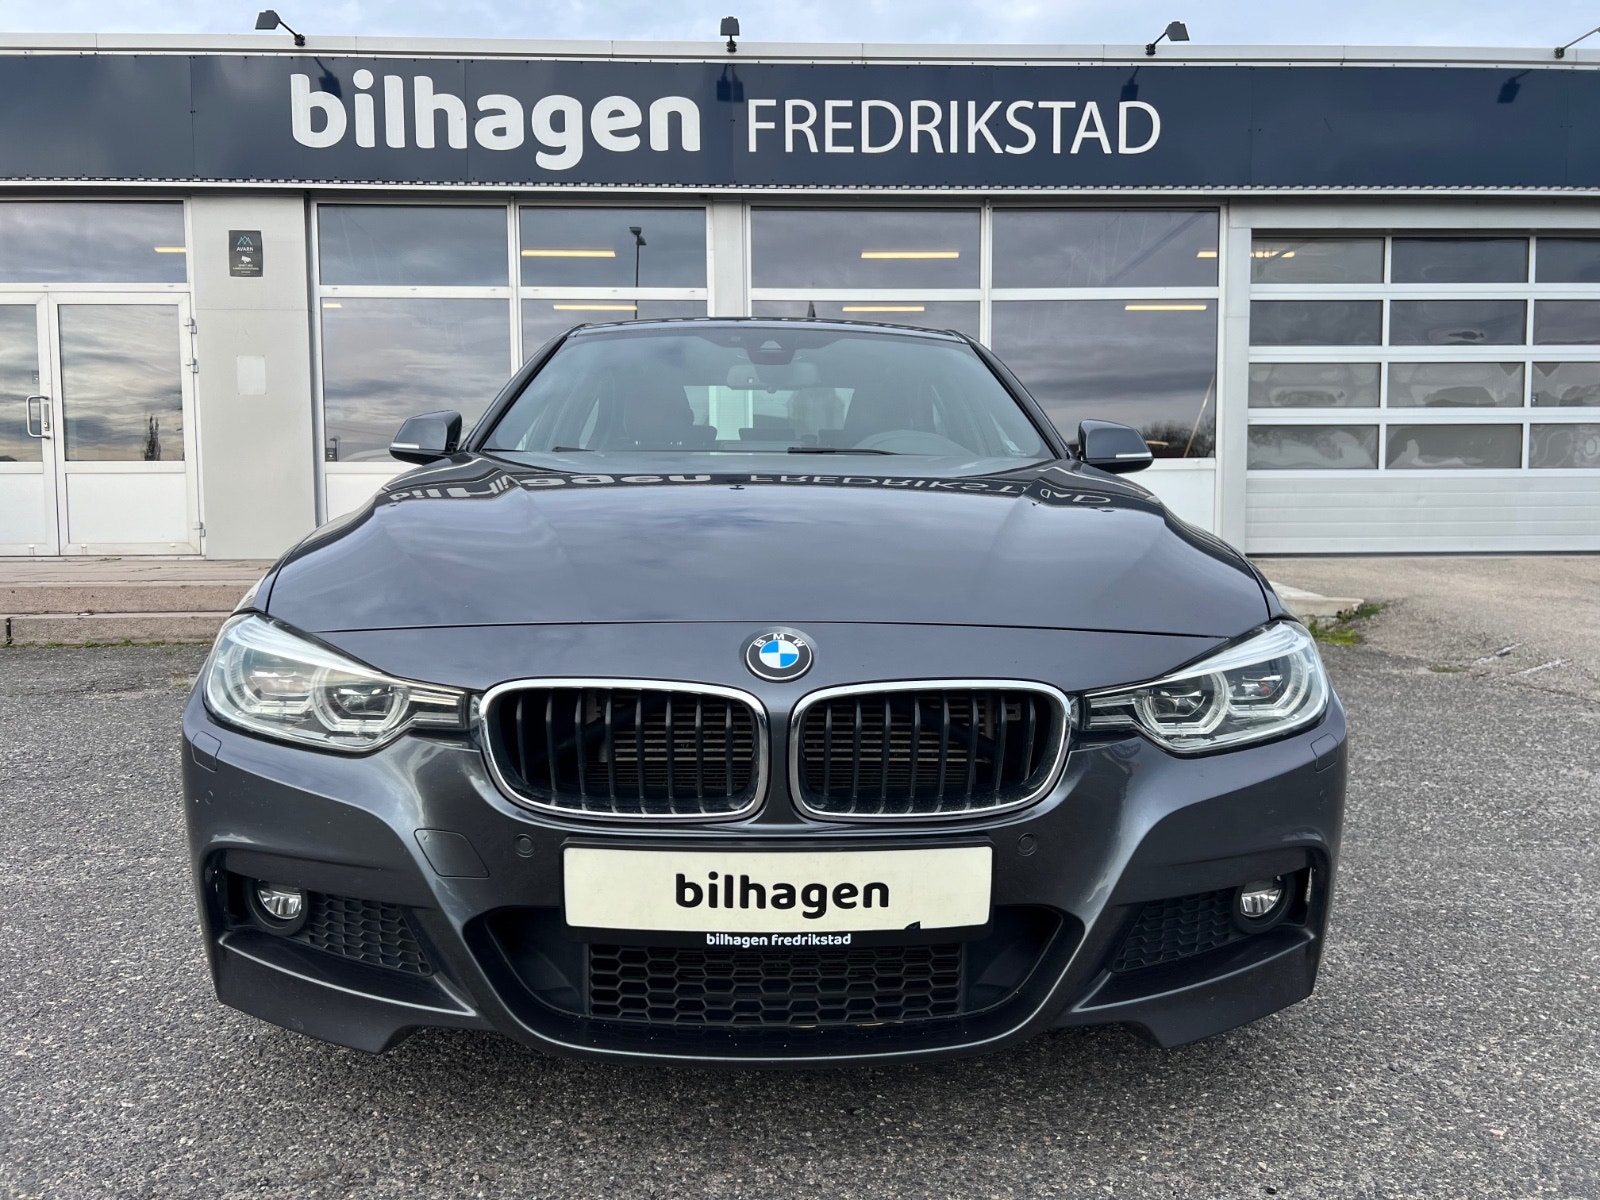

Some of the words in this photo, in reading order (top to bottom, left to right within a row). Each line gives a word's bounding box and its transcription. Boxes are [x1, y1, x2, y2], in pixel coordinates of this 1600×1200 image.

[290, 69, 701, 171] bilhagen
[747, 99, 1162, 155] FREDRIKSTAD
[753, 633, 806, 647] BMW
[675, 871, 890, 919] bilhagen
[706, 933, 768, 949] bilhagen
[771, 933, 852, 946] fredrikstad
